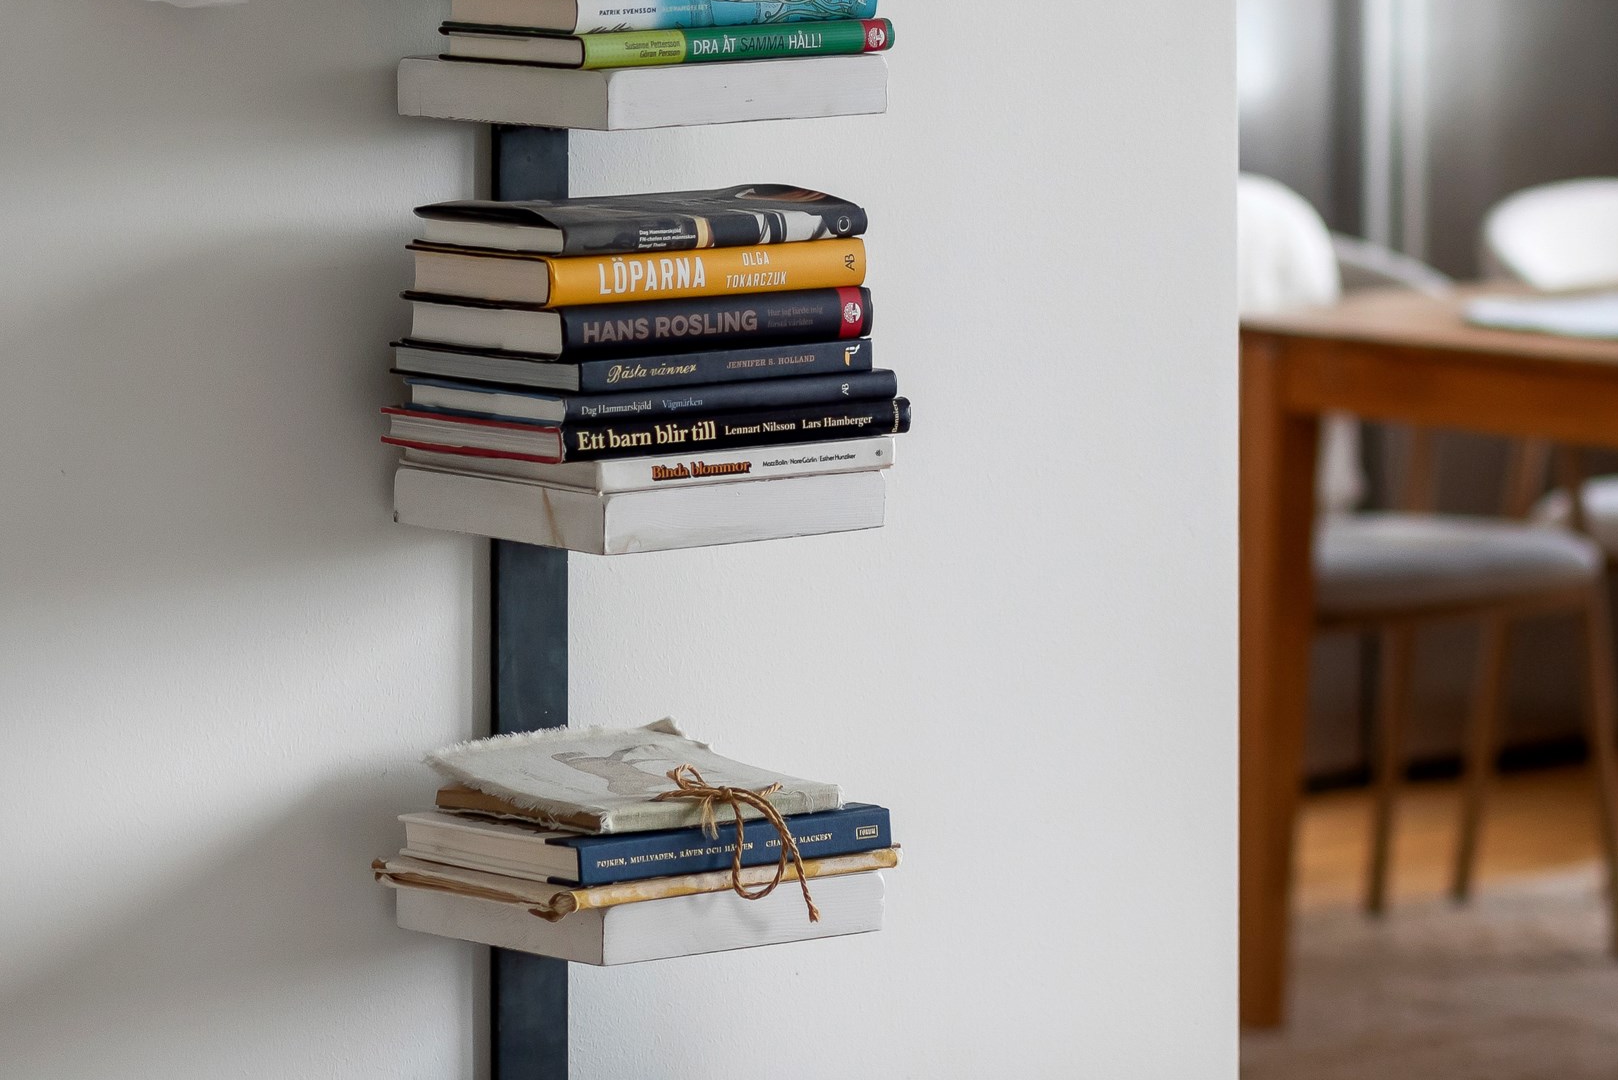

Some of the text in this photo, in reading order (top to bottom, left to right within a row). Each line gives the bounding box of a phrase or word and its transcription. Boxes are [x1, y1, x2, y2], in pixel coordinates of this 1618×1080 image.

[599, 8, 621, 16] PATRIK
[622, 7, 657, 15] SVENSSON
[624, 40, 680, 50] Susanne Pettersson
[693, 30, 822, 55] DRA ÅT SAMMA HÅLL!
[639, 49, 680, 58] Göran Persson
[742, 251, 770, 266] OLGA
[844, 253, 856, 271] AB
[598, 256, 706, 295] LÖPARNA
[726, 272, 787, 289] TOKARCZUK
[583, 309, 758, 344] HANS ROSLING
[726, 358, 766, 369] JENNIFER
[778, 354, 815, 365] HOLLAND
[606, 362, 697, 384] Bästa vänner
[581, 397, 703, 417] Dag Hammarskjöld Vägmärken
[576, 415, 873, 451] Ett barn blir till Lennart Nilsson Lars Hamberger
[651, 463, 691, 482] Binda
[690, 460, 752, 479] blommor
[596, 858, 627, 869] POJKEN,
[630, 852, 677, 864] MULLVADEN,
[679, 847, 704, 858] RÄVEN
[706, 846, 722, 855] OCH
[724, 842, 754, 852] HÄTEN
[799, 833, 833, 844] MACKESY
